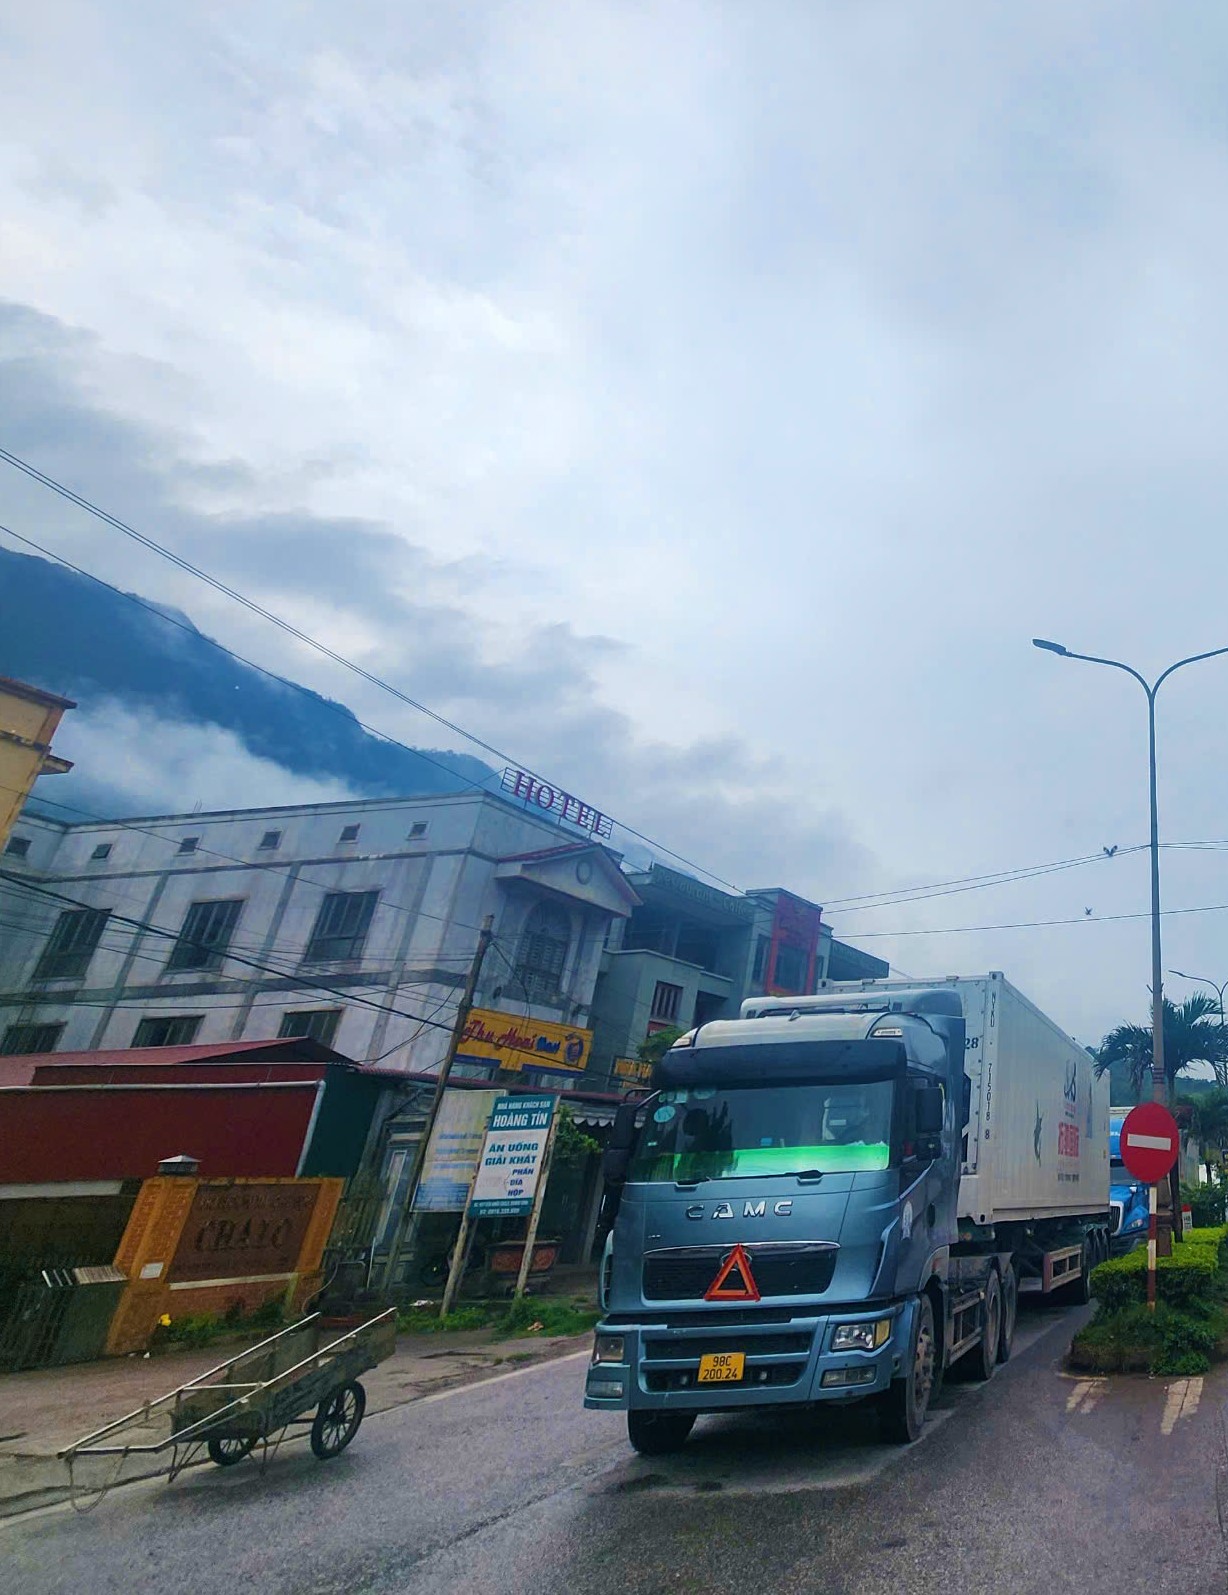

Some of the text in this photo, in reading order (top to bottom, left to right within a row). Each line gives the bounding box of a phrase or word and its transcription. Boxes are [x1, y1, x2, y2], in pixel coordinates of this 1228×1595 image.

[514, 771, 610, 837] HOTEL
[493, 1110, 548, 1127] HOÀNG TÍN
[509, 1154, 537, 1165] KHÁT
[686, 1200, 793, 1220] CAMC
[713, 1355, 732, 1367] 98C
[703, 1368, 738, 1381] 200.24
